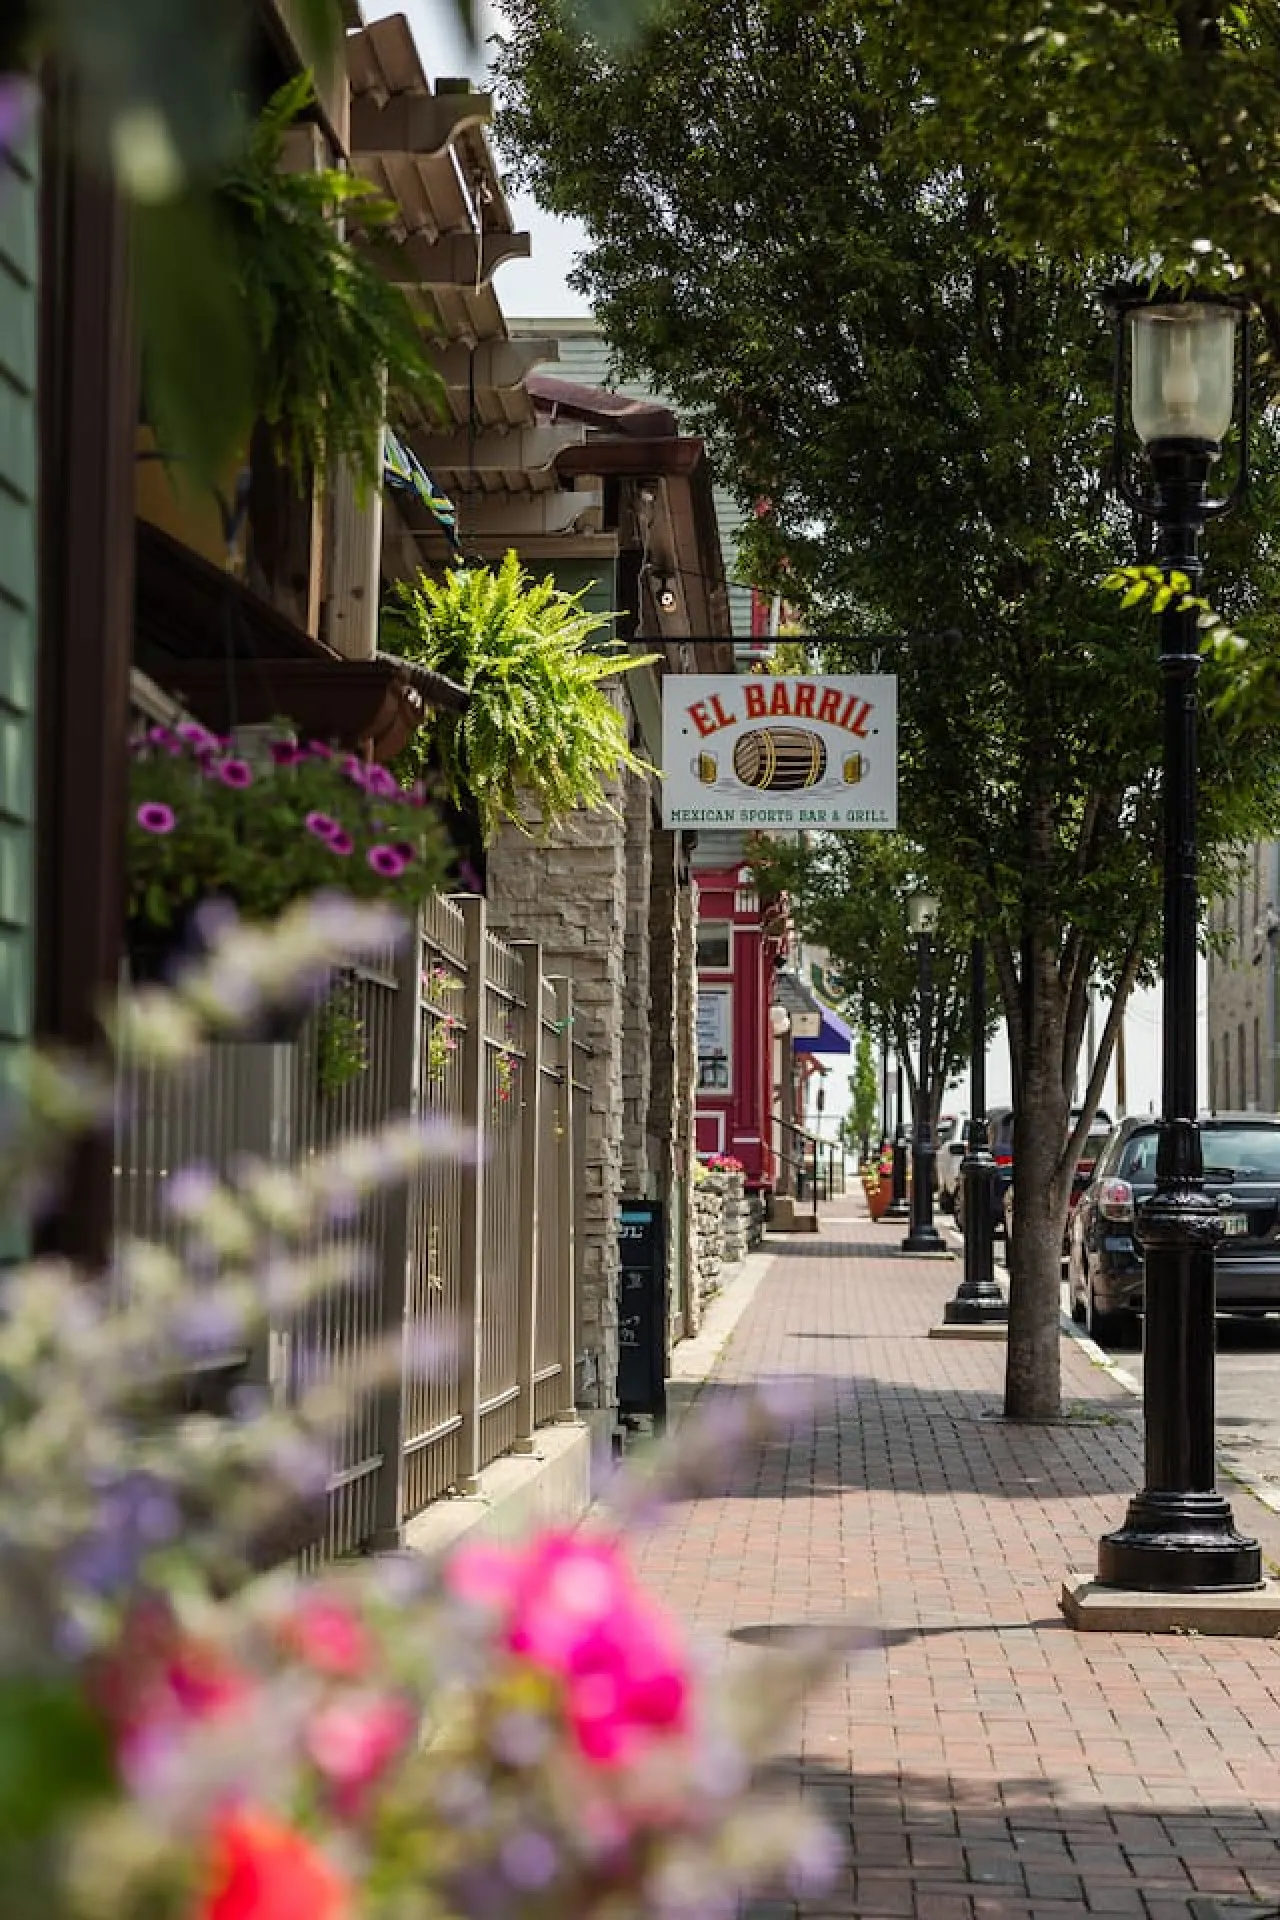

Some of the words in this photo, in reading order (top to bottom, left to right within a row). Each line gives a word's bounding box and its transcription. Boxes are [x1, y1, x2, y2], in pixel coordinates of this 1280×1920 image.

[687, 694, 736, 738] EL
[743, 681, 875, 739] BARRIL
[671, 809, 735, 822] MEXICAN
[740, 809, 794, 822] SPORTS
[799, 809, 827, 822] BAR
[830, 809, 841, 822] &
[846, 809, 889, 822] GRILL
